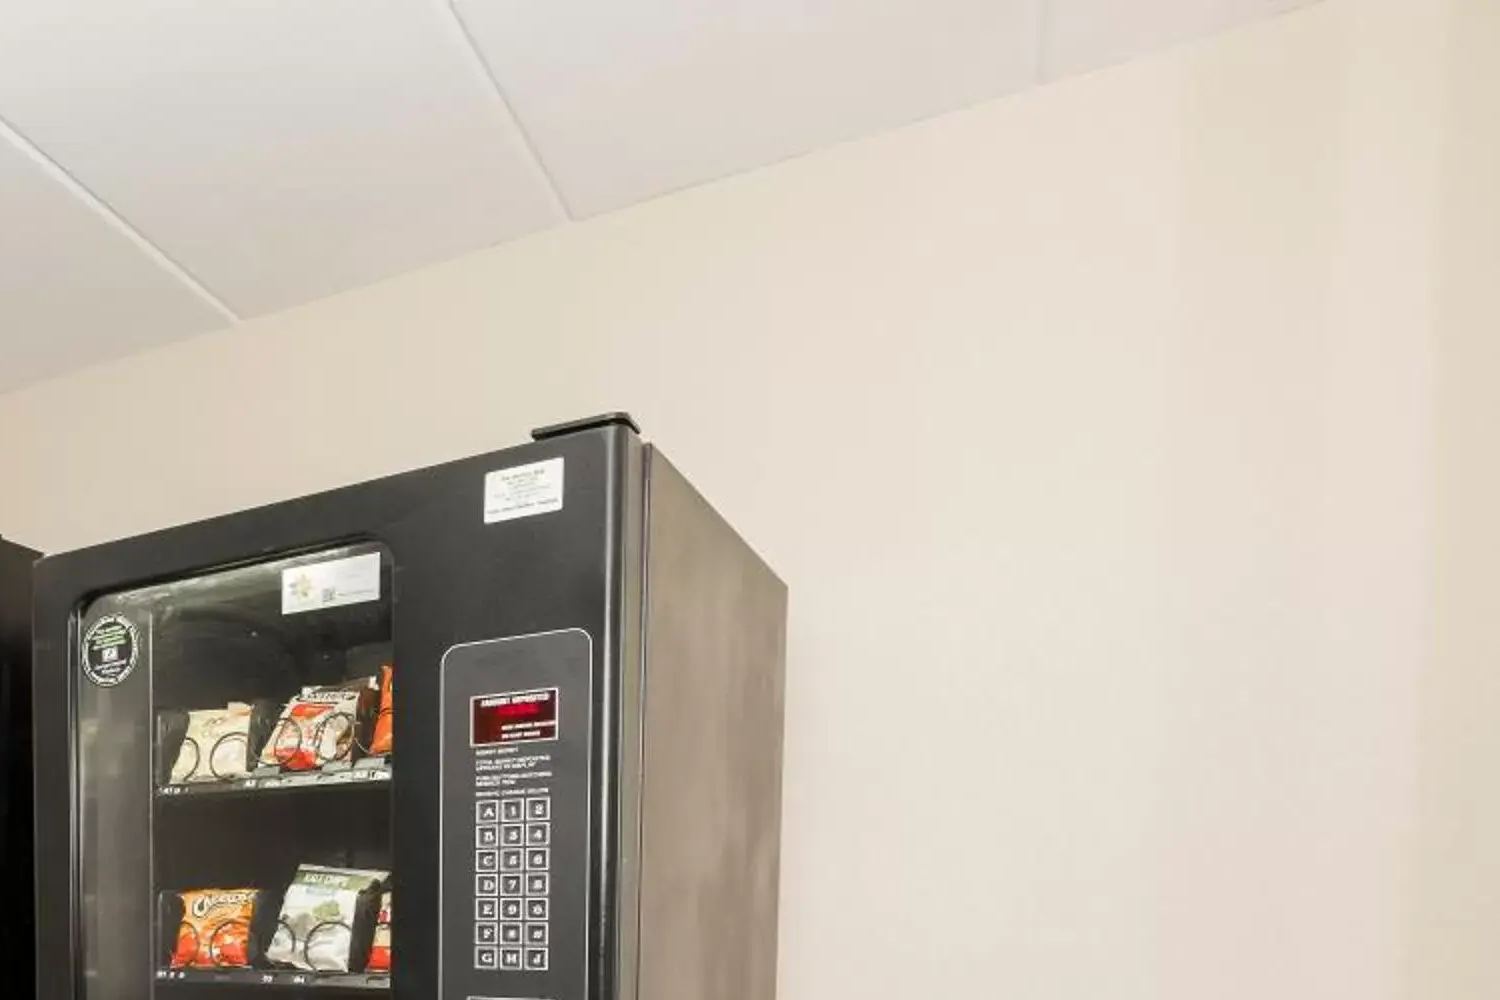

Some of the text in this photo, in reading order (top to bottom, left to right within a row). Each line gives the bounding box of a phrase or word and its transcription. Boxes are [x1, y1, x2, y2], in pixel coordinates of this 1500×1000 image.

[483, 807, 495, 818] A
[483, 855, 493, 866] C
[483, 880, 494, 891] D
[481, 952, 493, 963] G
